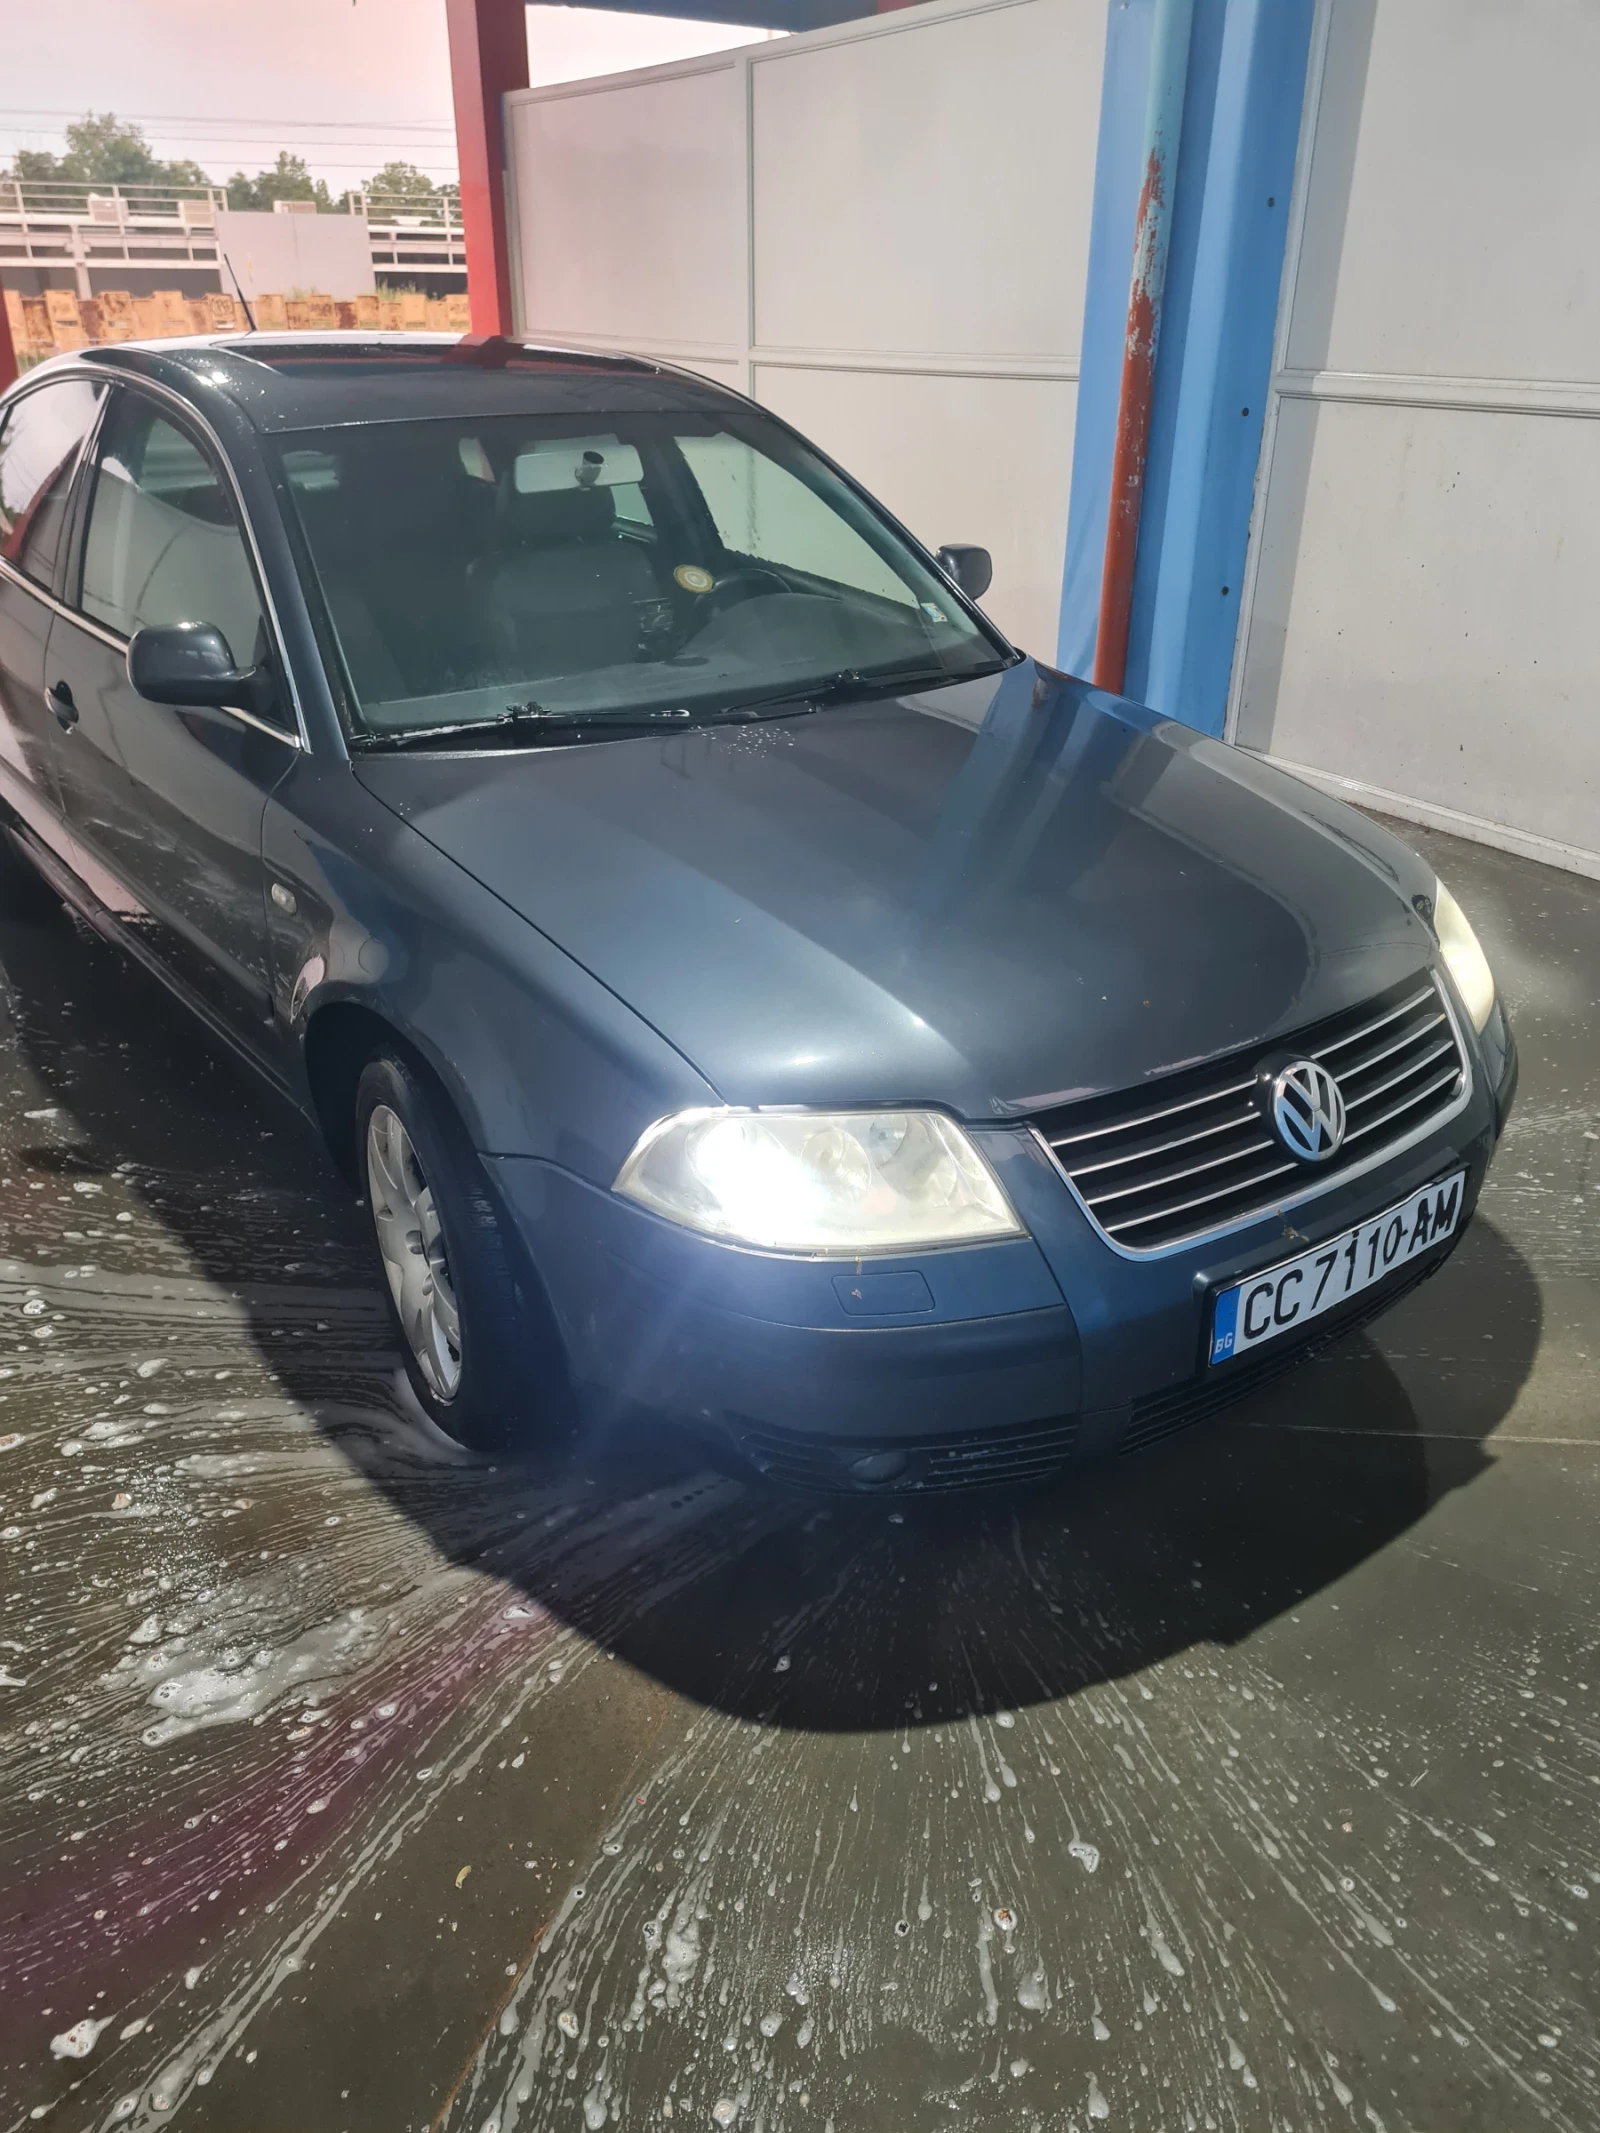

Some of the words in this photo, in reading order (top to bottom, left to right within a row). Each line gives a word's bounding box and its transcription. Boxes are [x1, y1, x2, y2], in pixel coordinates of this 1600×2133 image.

[1274, 1061, 1346, 1161] VW
[1243, 1269, 1303, 1340] CC
[1310, 1214, 1402, 1312] 7110
[1408, 1181, 1459, 1254] AM
[1214, 1332, 1234, 1355] BG
